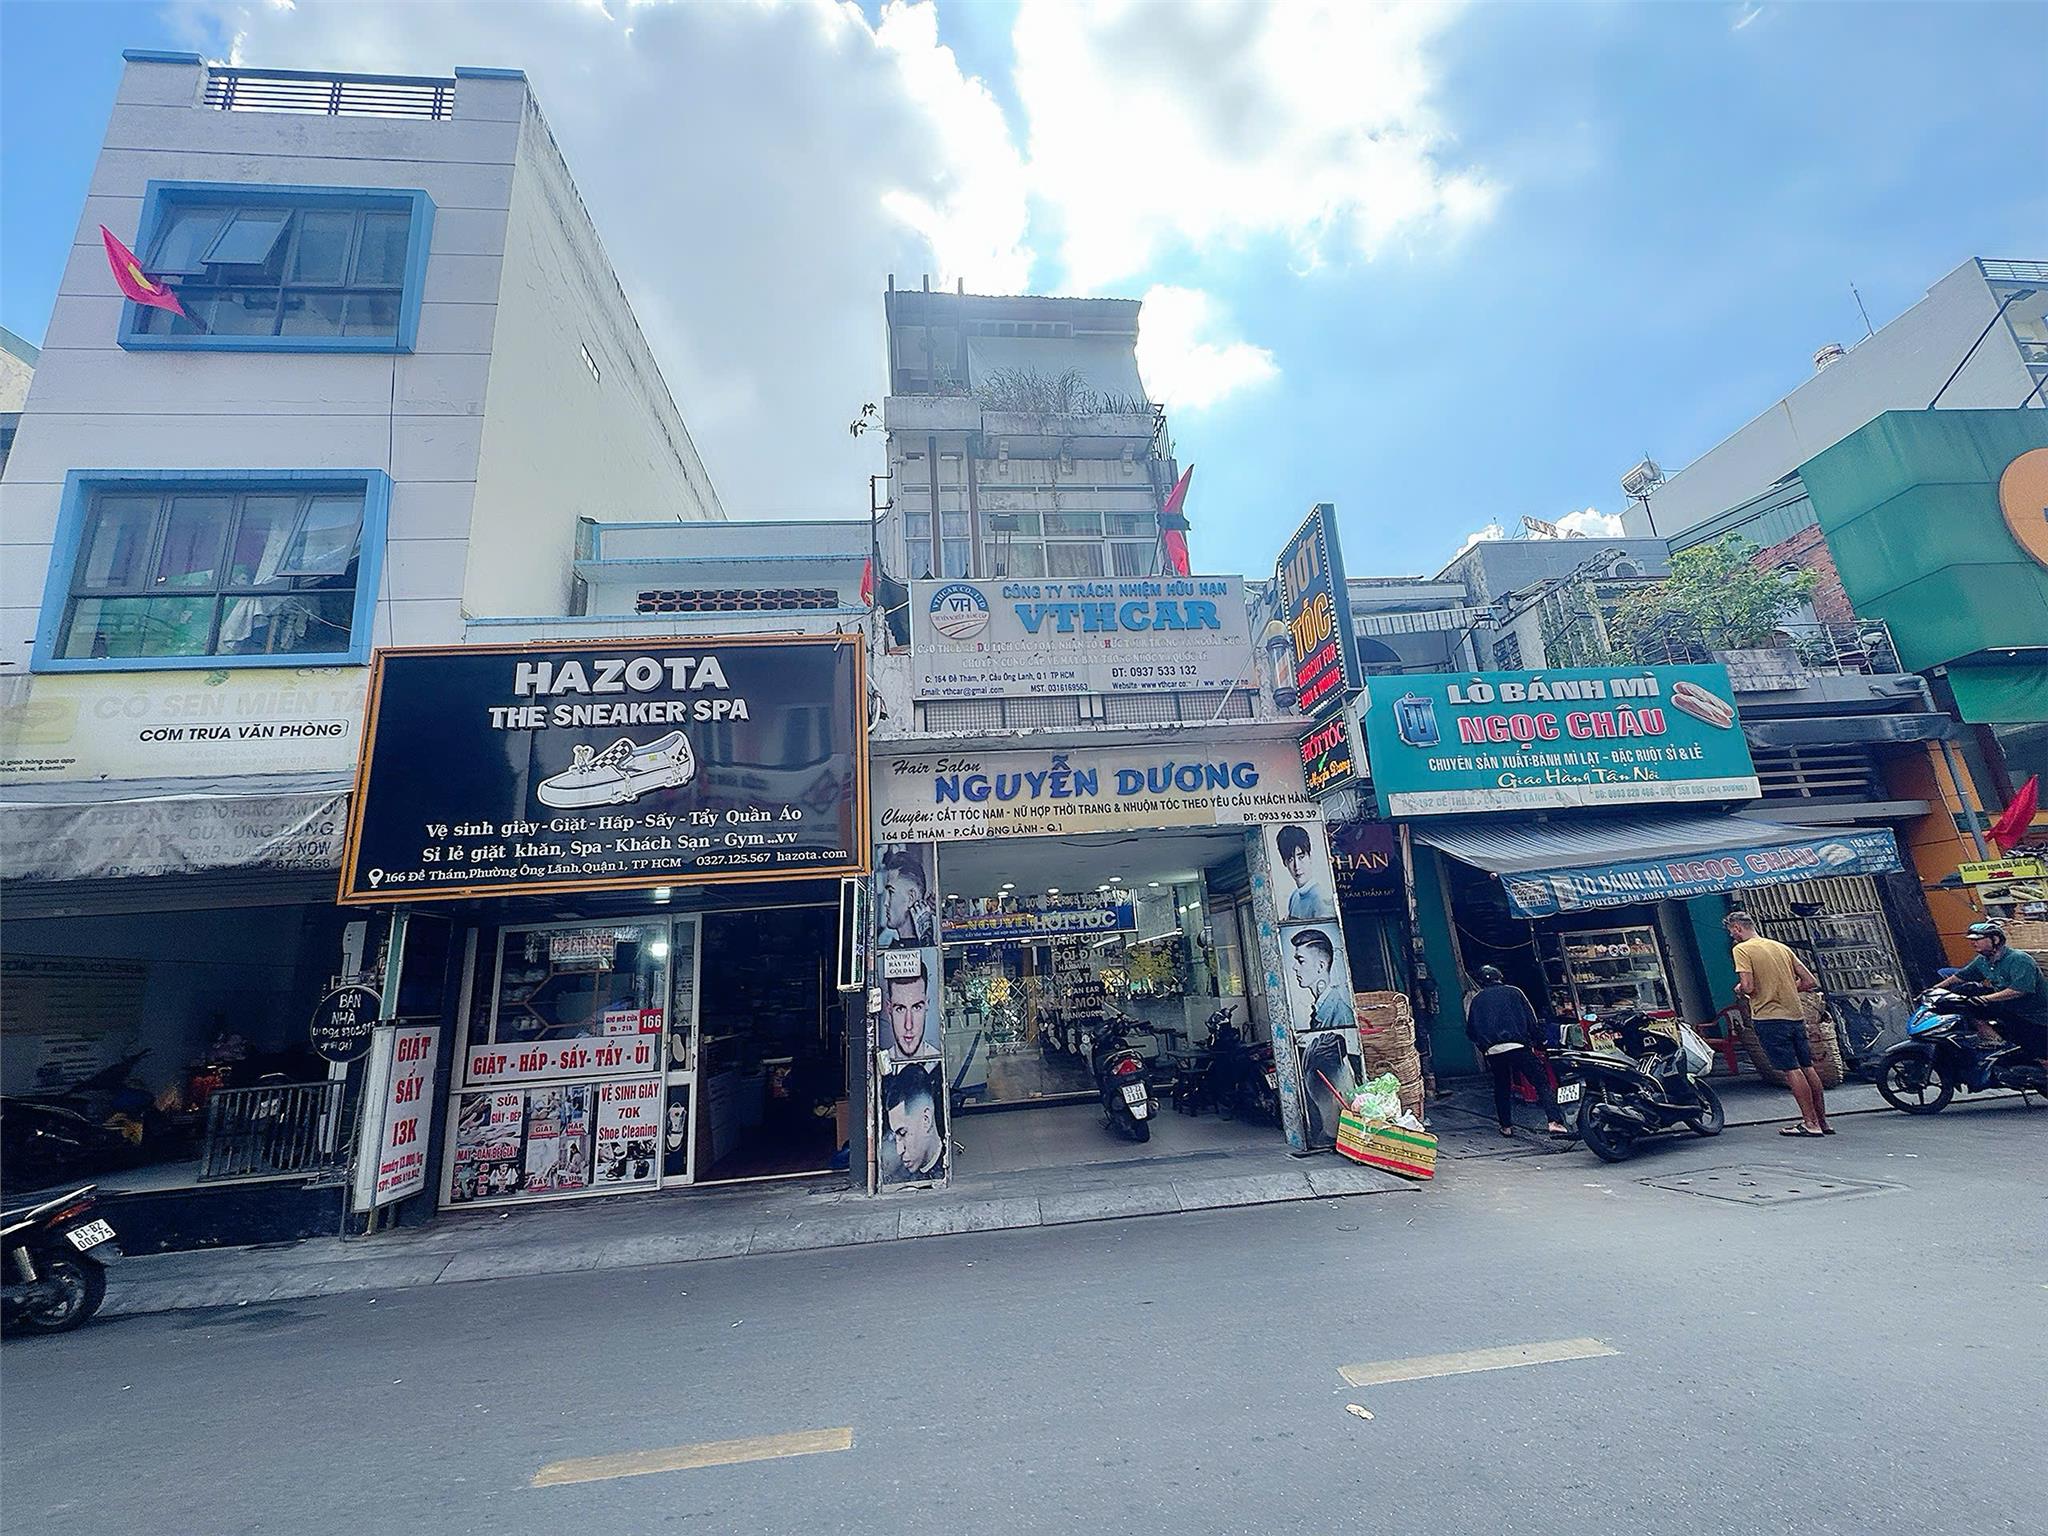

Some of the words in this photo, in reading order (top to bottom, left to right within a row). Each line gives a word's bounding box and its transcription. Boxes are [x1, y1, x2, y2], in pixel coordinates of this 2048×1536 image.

[1002, 583, 1041, 599] CÔNG
[1045, 585, 1063, 599] TY
[1067, 582, 1114, 599] TRÁCH
[1119, 580, 1162, 599] NHIỆM
[1167, 580, 1194, 597] HỮU
[1200, 582, 1227, 598] HẠN
[949, 598, 971, 612] VTH
[1015, 599, 1221, 634] VTHCAR
[1292, 592, 1333, 663] TÓC
[1322, 642, 1337, 667] FOR
[514, 656, 730, 696] HAZOTA
[1130, 666, 1154, 677] 0937
[1157, 666, 1176, 676] 533
[1179, 665, 1197, 675] 132
[1447, 677, 1495, 705] LÒ
[1500, 675, 1607, 703] BÁNH
[1610, 671, 1661, 698] MÌ
[489, 705, 547, 729] THE
[552, 701, 687, 726] SNEAKER
[693, 699, 749, 722] SPA
[139, 726, 184, 742] CƠM
[189, 725, 231, 741] TRƯA
[238, 723, 275, 739] VĂN
[279, 722, 343, 738] PHÒNG
[1457, 713, 1561, 750] NGỌC
[1565, 704, 1668, 739] CHÂU
[892, 759, 930, 776] Hair
[934, 757, 982, 774] Salon
[1428, 755, 1473, 772] CHUYÊN
[1475, 752, 1499, 770] SẢN
[1563, 750, 1579, 766] MÌ
[1582, 750, 1600, 768] LẠT
[1611, 748, 1634, 767] ĐẶC
[1636, 746, 1663, 766] RUỘT
[1679, 749, 1690, 760] &
[1690, 742, 1704, 760] LẺ
[934, 753, 1099, 804] NGUYỄN
[1114, 761, 1260, 797] DƯƠNG
[1498, 772, 1541, 793] Giao
[1545, 767, 1592, 792] Hàng
[1592, 767, 1630, 784] Tận
[881, 807, 934, 828] Chuyên:
[936, 805, 957, 822] CẮT
[960, 805, 980, 821] TÓC
[982, 807, 1004, 819] NAM
[1014, 803, 1028, 818] NỮ
[1031, 804, 1050, 819] HỢP
[1053, 802, 1076, 816] THỜI
[1079, 801, 1111, 815] TRANG
[1115, 802, 1121, 813] &
[1123, 800, 1158, 814] NHUỘM
[1160, 797, 1180, 811] TÓC
[1184, 797, 1208, 809] THEO
[1210, 794, 1229, 807] YÊU
[1254, 791, 1287, 805] KHÁCH
[1243, 812, 1257, 822] ĐT:
[1258, 811, 1280, 821] 0933
[1281, 811, 1292, 820] 96
[1293, 810, 1305, 820] 33
[1305, 810, 1317, 819] 39
[426, 823, 449, 841] Vệ
[454, 821, 494, 837] sinh
[726, 805, 772, 826] Quần
[778, 804, 803, 821] Áo
[881, 831, 898, 841] 164
[916, 827, 945, 839] THÁM
[986, 826, 1009, 837] ÔNG
[1012, 823, 1038, 834] LÃNH
[1047, 823, 1063, 833] Q.1
[297, 841, 332, 855] NOW
[423, 846, 440, 862] Sỉ
[448, 845, 463, 861] lẻ
[470, 844, 506, 863] giặt
[514, 842, 567, 859] khăn,
[570, 841, 602, 858] Spa
[615, 835, 672, 853] Khách
[678, 833, 710, 852] Sạn
[724, 831, 764, 849] Gym
[385, 871, 405, 882] 166
[408, 868, 425, 882] Đề
[520, 862, 545, 878] Ông
[632, 859, 649, 870] TP
[651, 858, 682, 870] HCM
[696, 852, 771, 866] 0327.125.567
[776, 850, 847, 863] hazota.com
[1600, 870, 1645, 894] BÁNH
[1646, 864, 1668, 889] MÌ
[1666, 856, 1744, 885] NGỌC
[1745, 846, 1821, 875] CHÂU
[339, 989, 361, 1008] BÁN
[331, 1008, 356, 1025] NHÀ
[642, 1014, 662, 1029] 166
[473, 1056, 507, 1079] GIẶT
[518, 1046, 548, 1073] HẤP
[560, 1043, 588, 1070] SẤY
[595, 1040, 623, 1068] TẨY
[635, 1039, 650, 1065] ỦI
[395, 1069, 425, 1104] SẤY
[601, 1084, 613, 1102] VỆ
[614, 1085, 636, 1101] SINH
[638, 1081, 660, 1099] GIÀY
[497, 1093, 519, 1107] SỬA
[618, 1106, 641, 1120] 70K
[392, 1118, 418, 1147] 13K
[599, 1126, 620, 1141] Shoe
[621, 1123, 657, 1141] Cleaning
[73, 1221, 104, 1239] 61-B2
